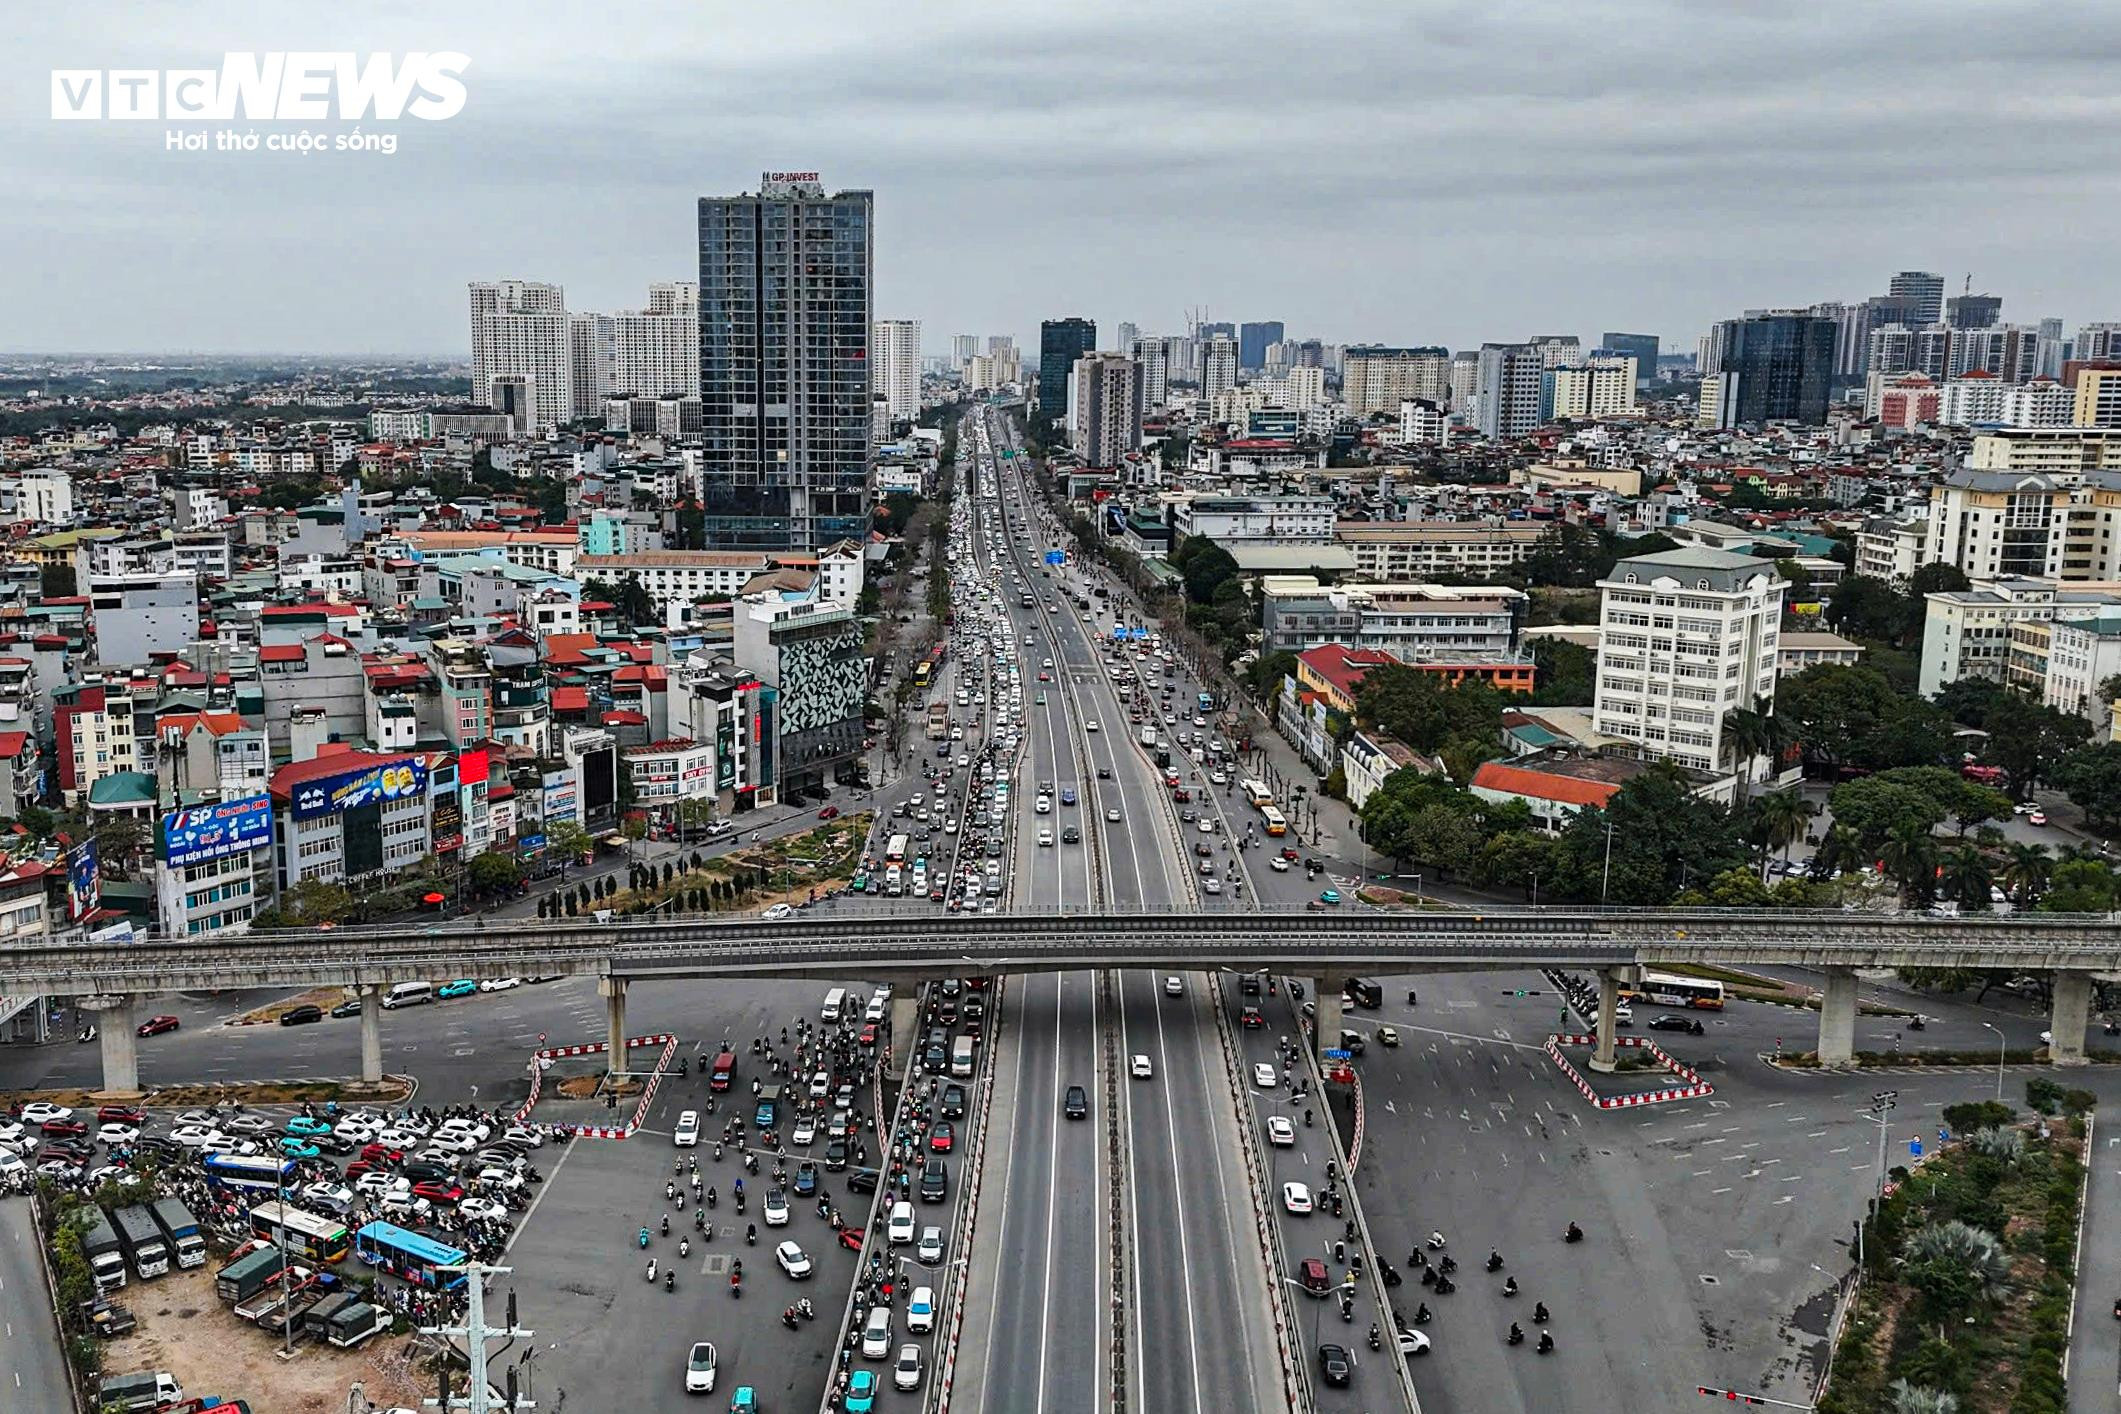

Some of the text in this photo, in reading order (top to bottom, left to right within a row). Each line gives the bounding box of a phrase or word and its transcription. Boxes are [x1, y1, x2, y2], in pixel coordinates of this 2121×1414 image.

[189, 807, 213, 827] SP
[170, 854, 185, 865] PHỤ
[185, 850, 202, 862] KIỆN
[202, 846, 214, 857] NỐI
[215, 843, 229, 855] ỐNG
[230, 839, 251, 851] THÔNG
